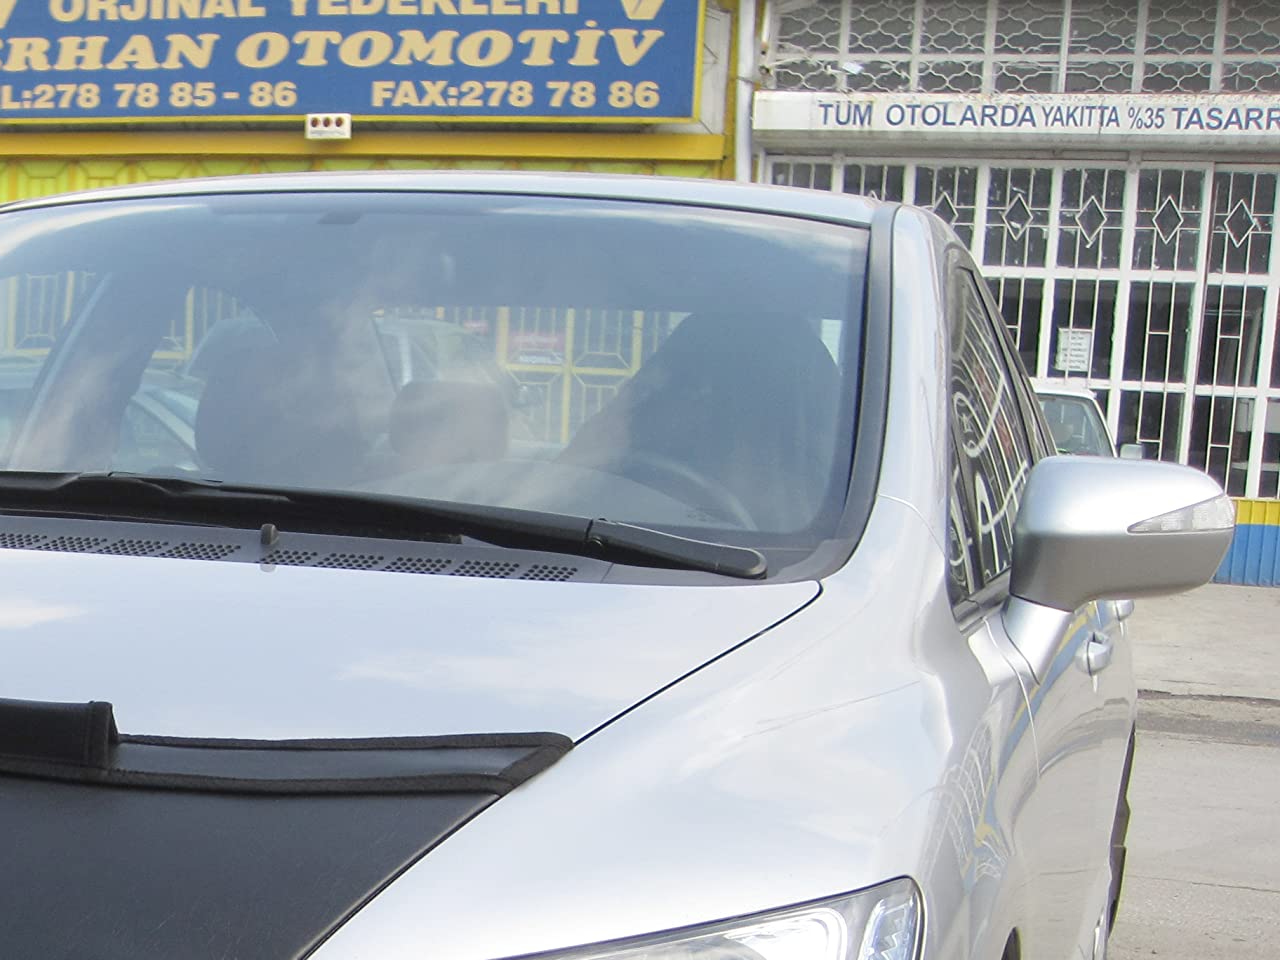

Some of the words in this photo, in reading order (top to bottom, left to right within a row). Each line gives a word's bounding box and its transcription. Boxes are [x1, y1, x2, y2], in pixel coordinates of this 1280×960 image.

[235, 20, 665, 68] OTOMOTİV
[113, 83, 159, 107] 78
[169, 82, 216, 107] 85
[248, 81, 298, 107] 86
[547, 81, 597, 107] 78
[608, 81, 660, 108] 86
[886, 103, 1036, 127] OTOLARDA
[1127, 106, 1165, 129] %35
